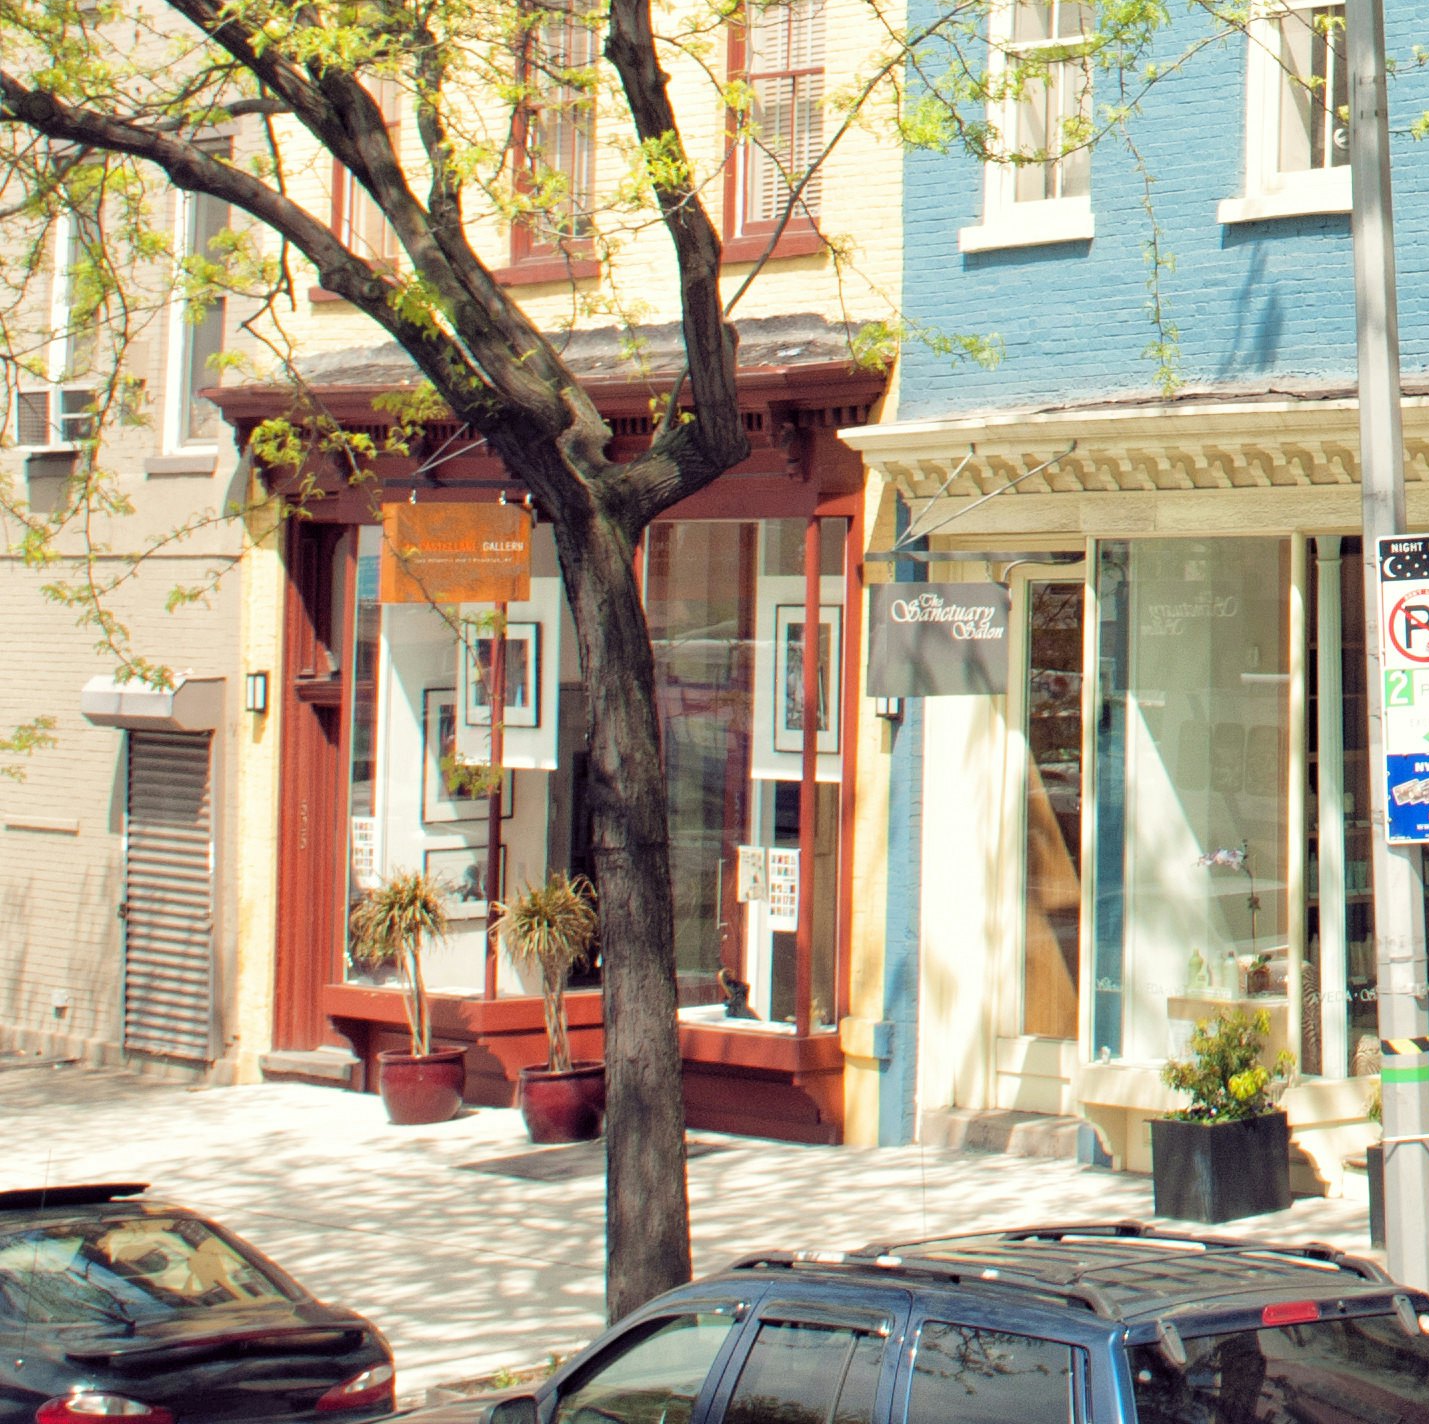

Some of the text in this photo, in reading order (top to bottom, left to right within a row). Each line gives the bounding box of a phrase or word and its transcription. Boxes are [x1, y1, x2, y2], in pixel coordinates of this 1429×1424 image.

[482, 541, 524, 552] GALLERY
[1390, 541, 1423, 554] NIGHT
[890, 599, 996, 625] Sanctuary
[951, 622, 1004, 640] Salon
[1388, 670, 1409, 705] 2
